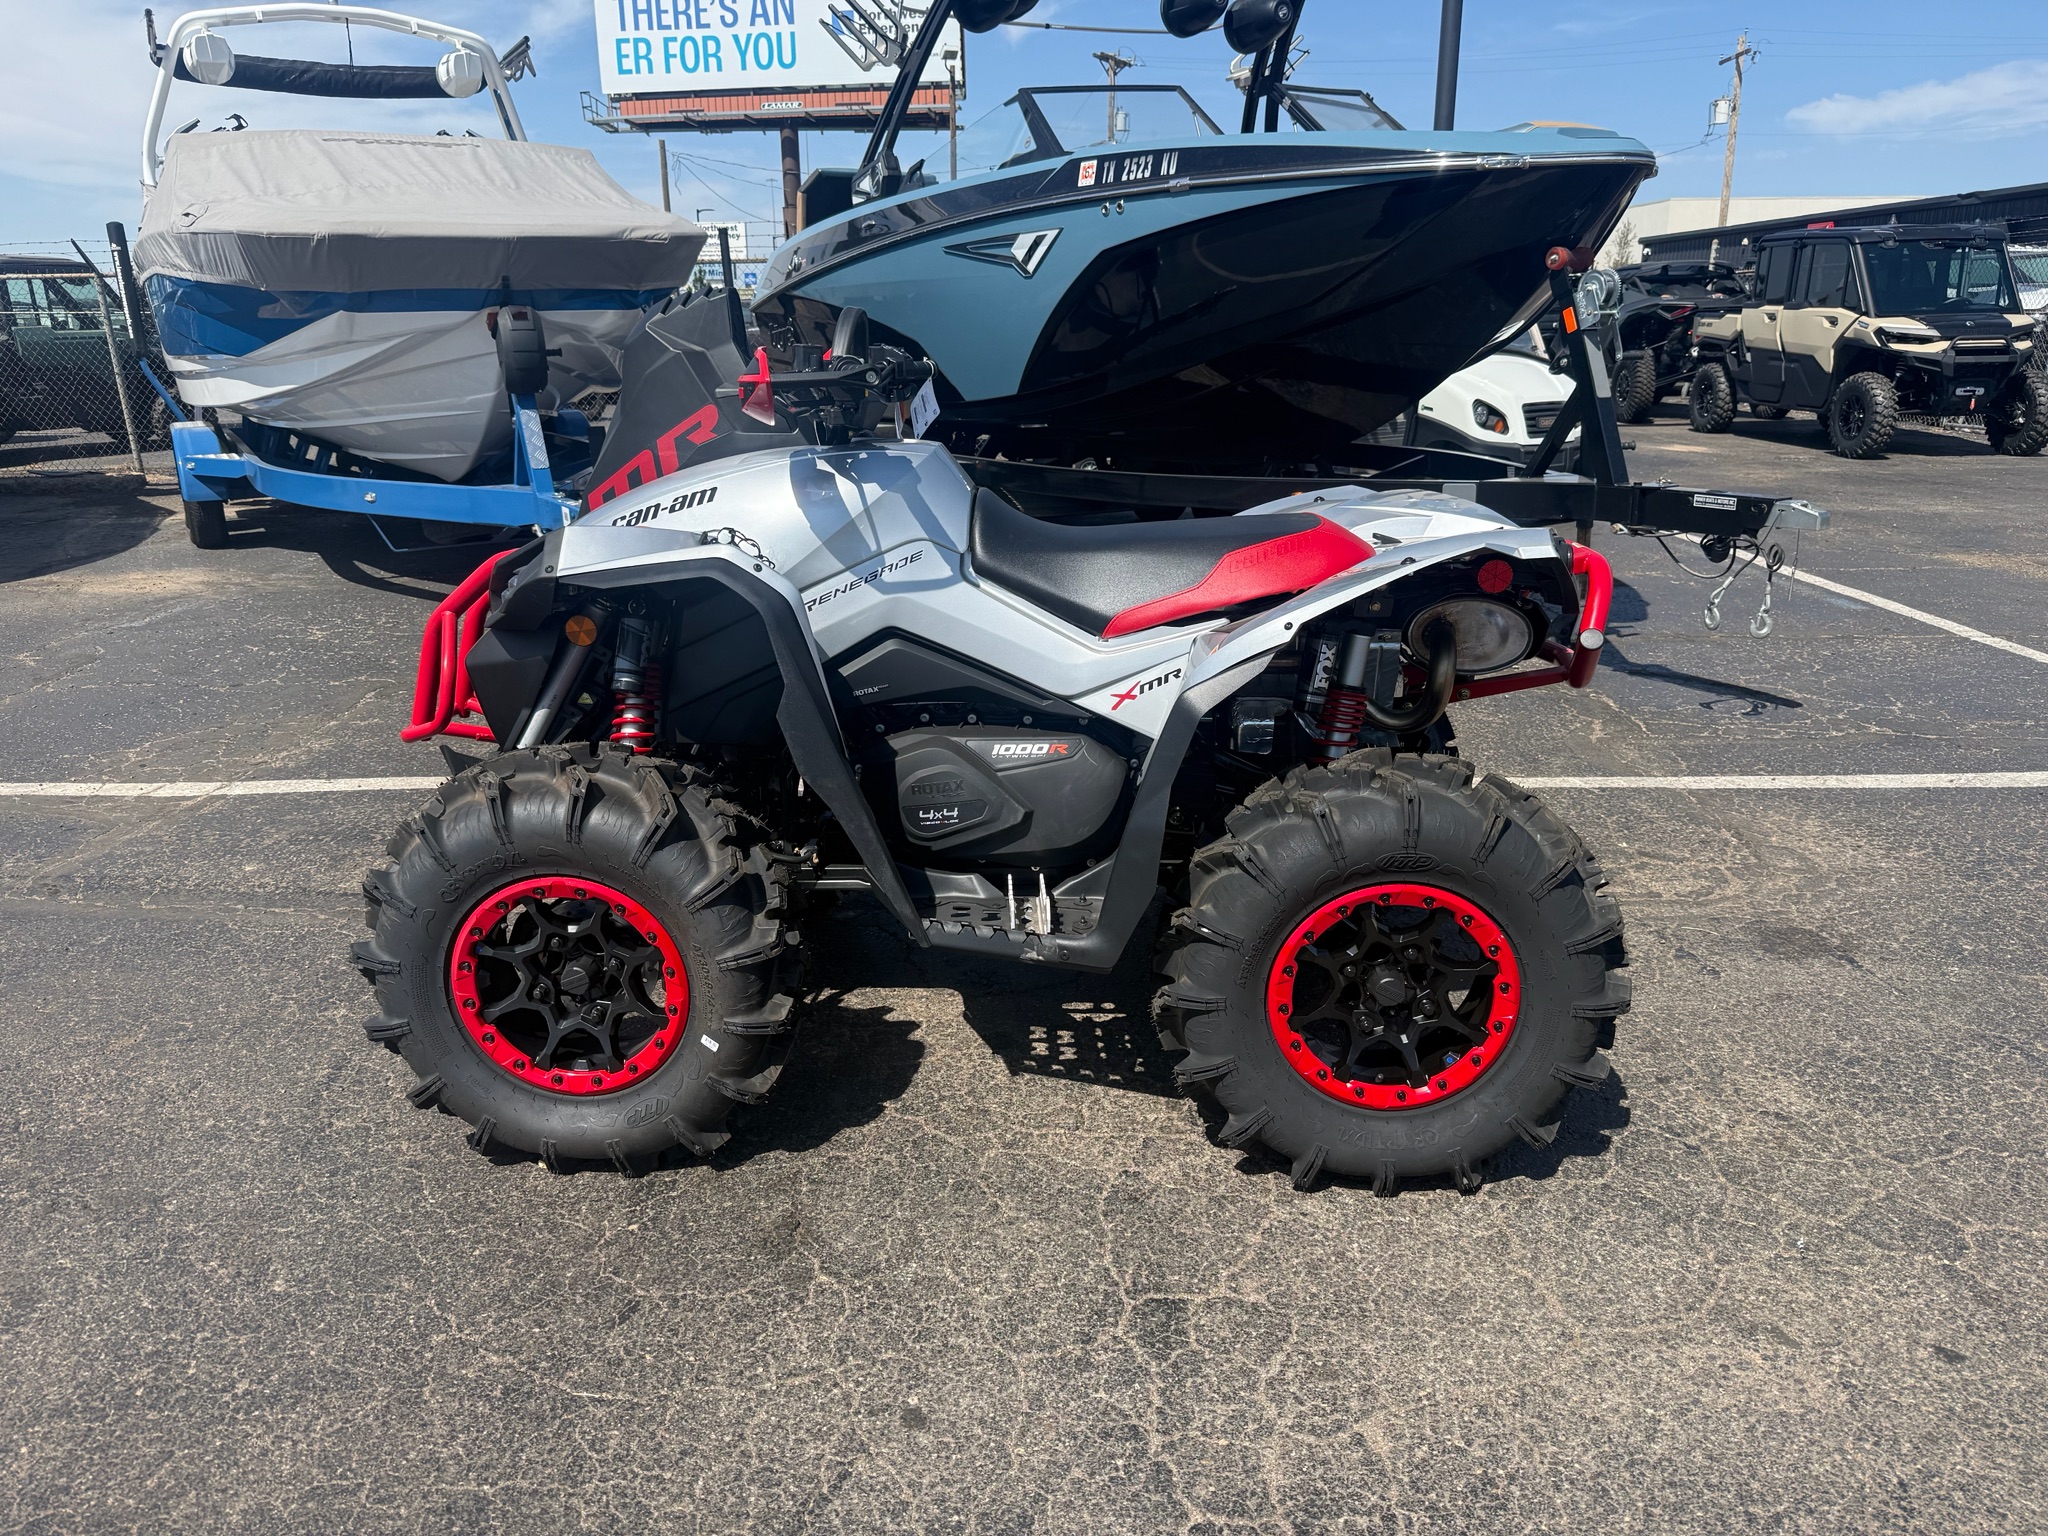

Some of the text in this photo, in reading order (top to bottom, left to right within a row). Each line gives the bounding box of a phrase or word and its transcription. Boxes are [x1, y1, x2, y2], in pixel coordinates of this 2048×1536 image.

[617, 0, 795, 32] THERE'S AN
[615, 31, 797, 75] ER FOR YOU
[1102, 161, 1116, 184] TX
[1121, 154, 1153, 182] 2523
[611, 486, 718, 527] can-am
[804, 549, 925, 612] RENEGADE
[1313, 643, 1337, 690] FOX
[852, 685, 879, 697] ROTAX
[991, 742, 1069, 756] 1000R
[911, 779, 965, 796] ROTAX
[918, 807, 959, 820] 4x4
[1379, 853, 1435, 869] ITP
[626, 1097, 664, 1127] ITP
